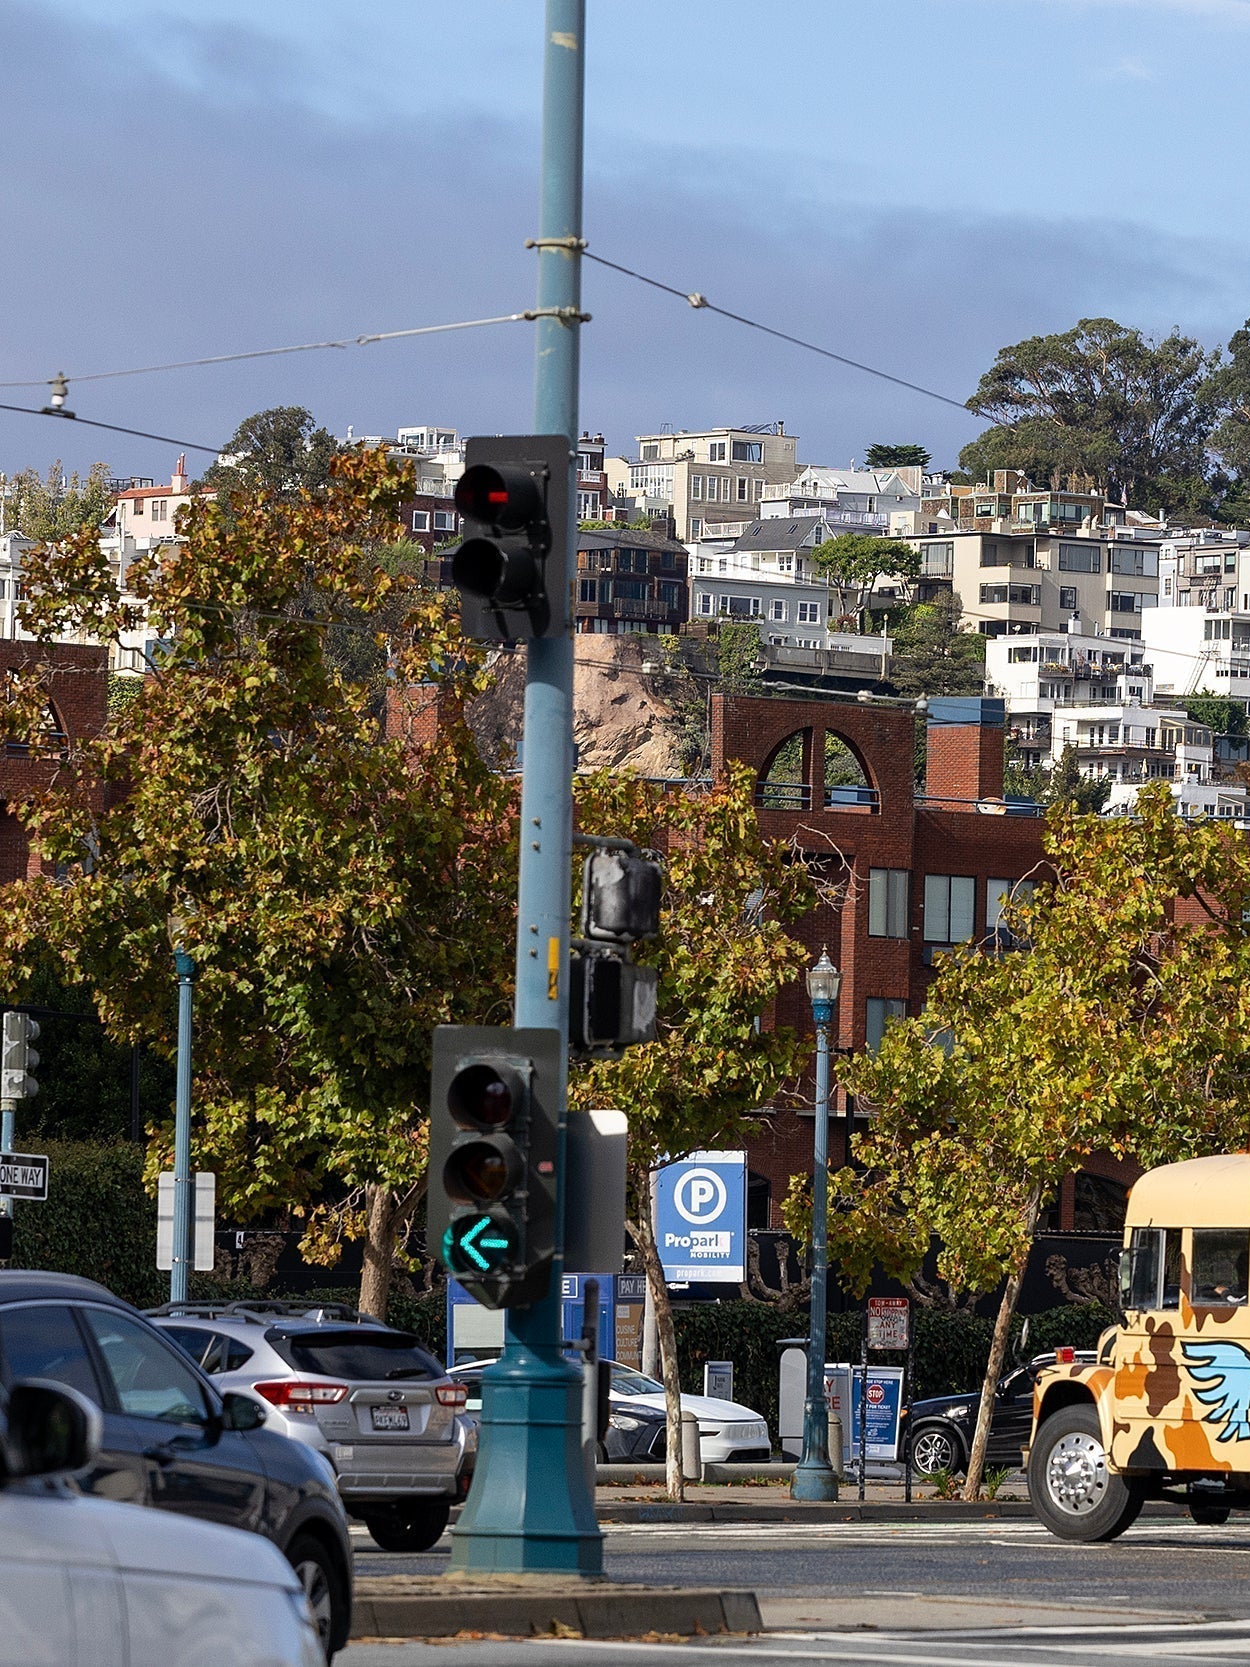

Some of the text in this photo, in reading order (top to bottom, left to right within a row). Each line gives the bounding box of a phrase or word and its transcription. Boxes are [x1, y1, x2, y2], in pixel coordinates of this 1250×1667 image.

[0, 1165, 42, 1186] ONE WAY
[691, 1180, 714, 1212] P
[621, 1280, 646, 1294] PAY HE
[870, 1307, 881, 1316] NO
[879, 1330, 898, 1338] TIME
